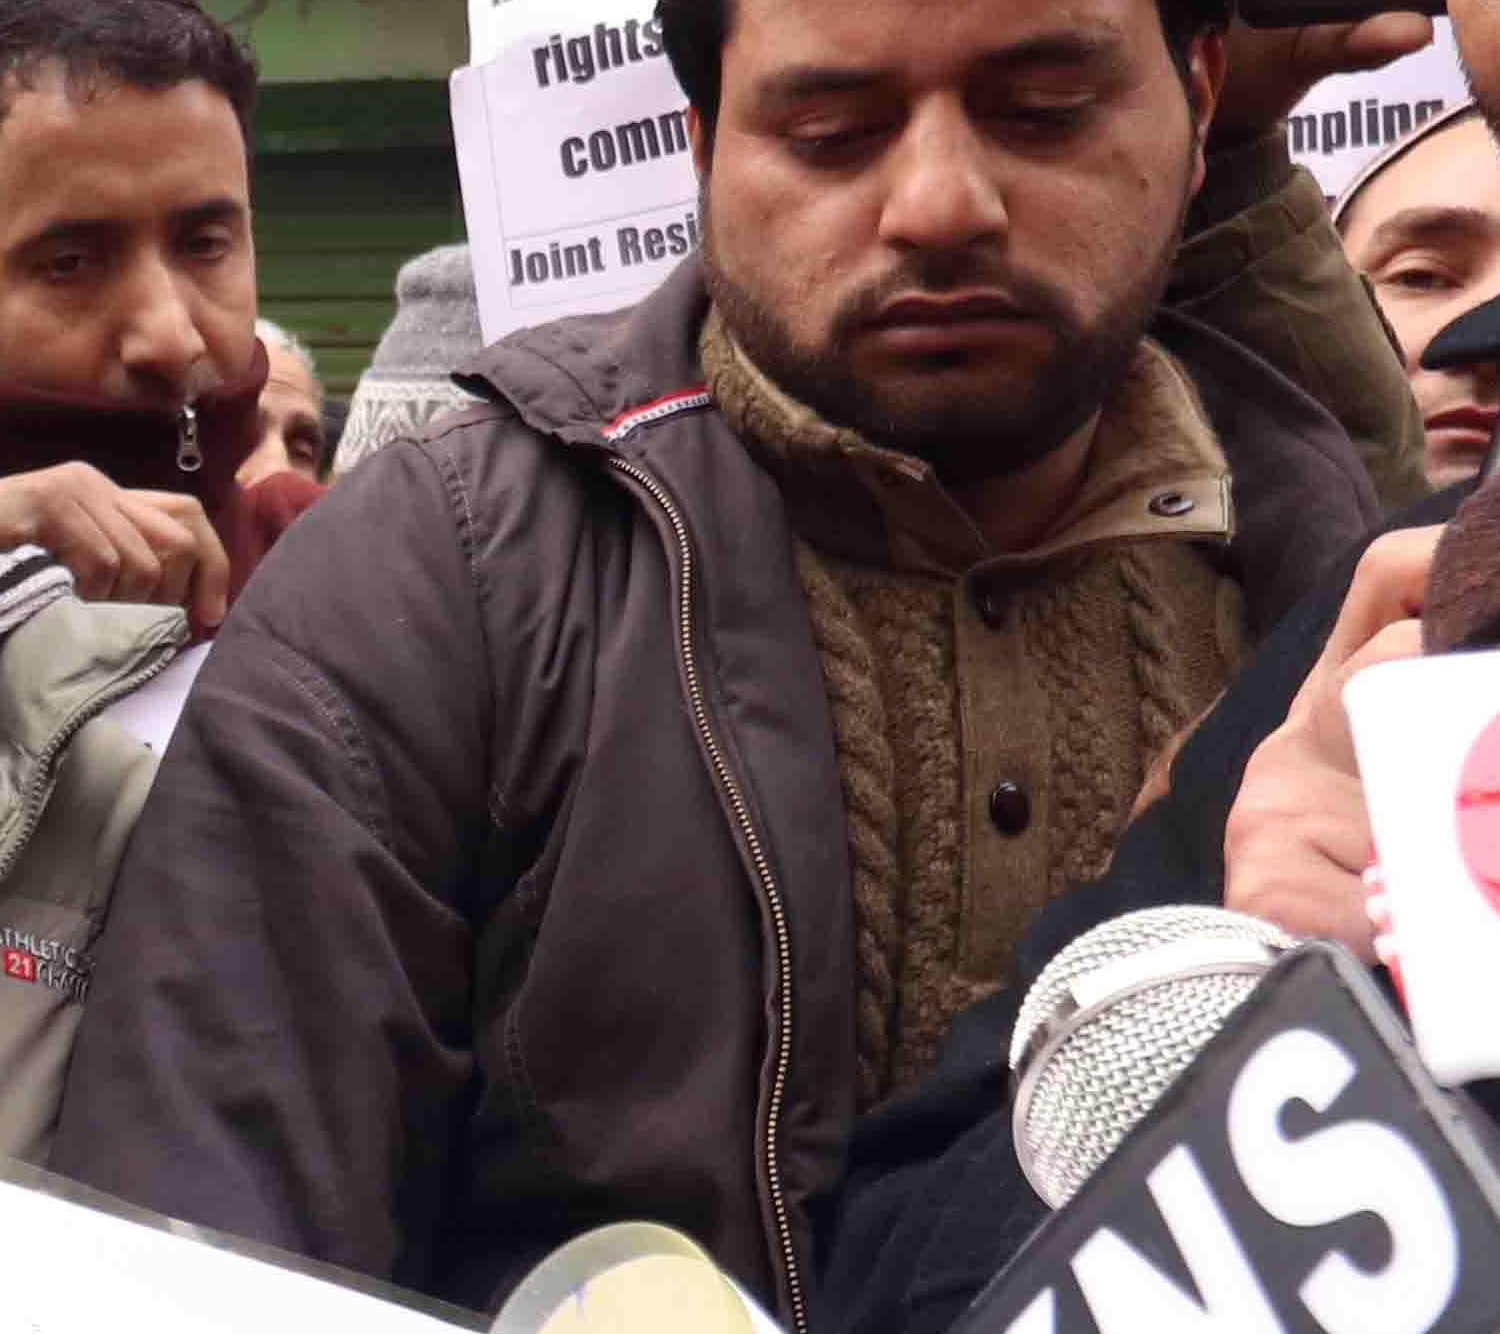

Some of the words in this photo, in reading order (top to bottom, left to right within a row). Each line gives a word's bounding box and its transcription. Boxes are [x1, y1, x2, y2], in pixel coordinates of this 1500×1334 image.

[532, 18, 665, 88] rights
[509, 236, 606, 286] Joint
[616, 212, 698, 267] Resi
[6, 951, 32, 979] 21
